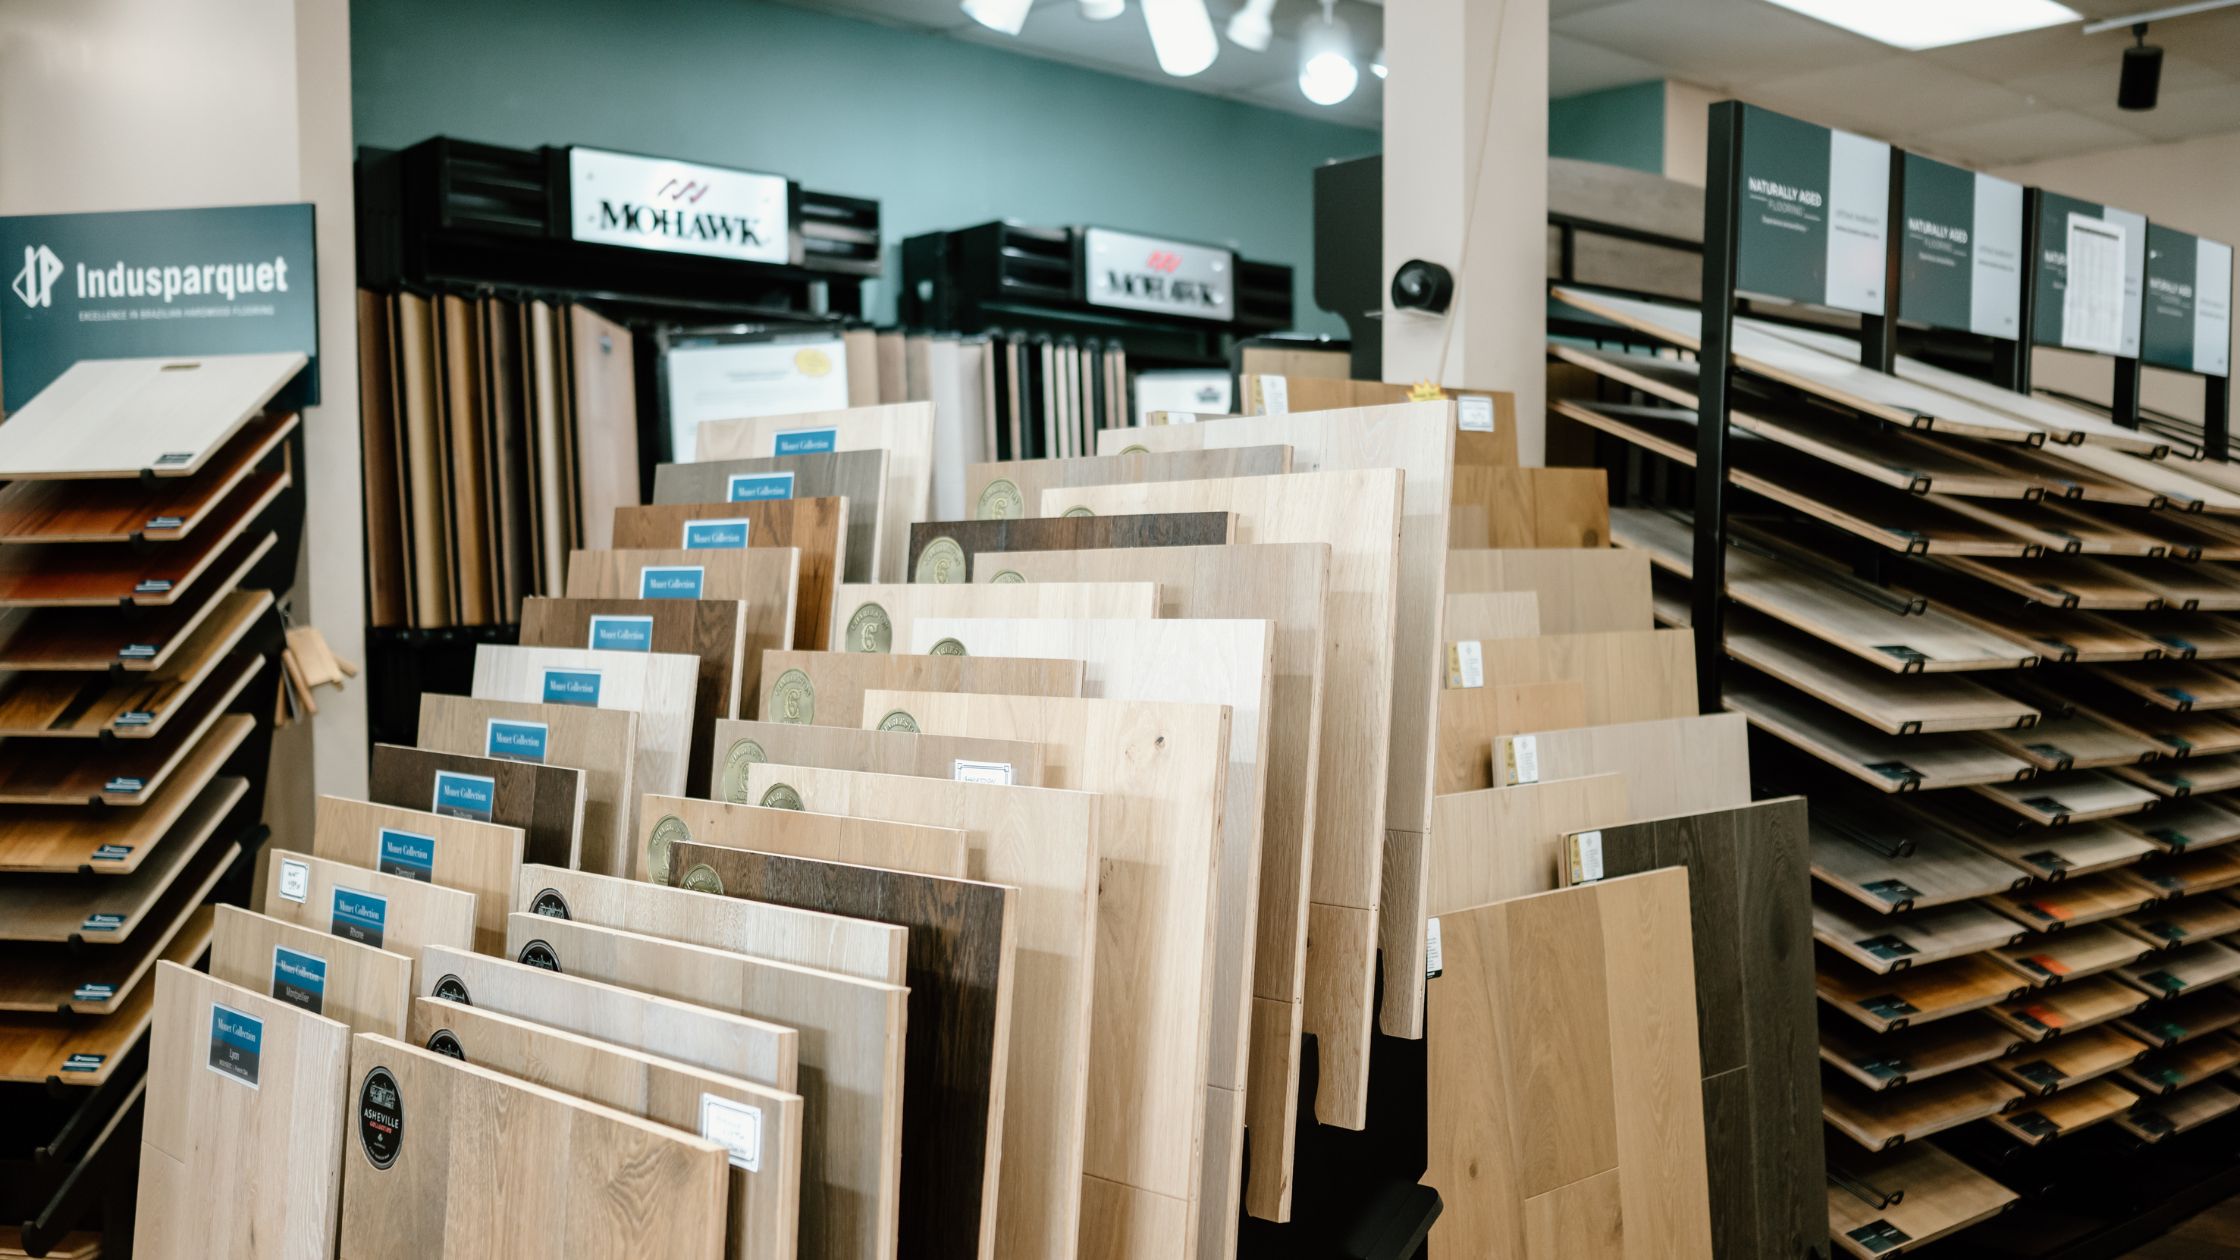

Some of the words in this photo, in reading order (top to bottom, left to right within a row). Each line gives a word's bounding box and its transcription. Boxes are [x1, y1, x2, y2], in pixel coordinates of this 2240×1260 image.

[1748, 176, 1798, 201] NATURALLY
[1798, 189, 1822, 207] AGED
[600, 200, 762, 247] MOHAWK
[1908, 217, 1948, 239] NATURALLY
[77, 256, 288, 303] Indusparquet
[513, 734, 539, 747] Collection
[460, 788, 486, 801] Collection
[403, 844, 427, 860] Collection
[339, 899, 354, 914] Monet
[355, 903, 379, 920] Collection
[295, 964, 319, 982] Collection
[217, 1018, 232, 1033] Monet
[232, 1023, 256, 1043] Collection
[229, 1048, 240, 1061] Lyon
[364, 1108, 399, 1129] ASHEVILLE
